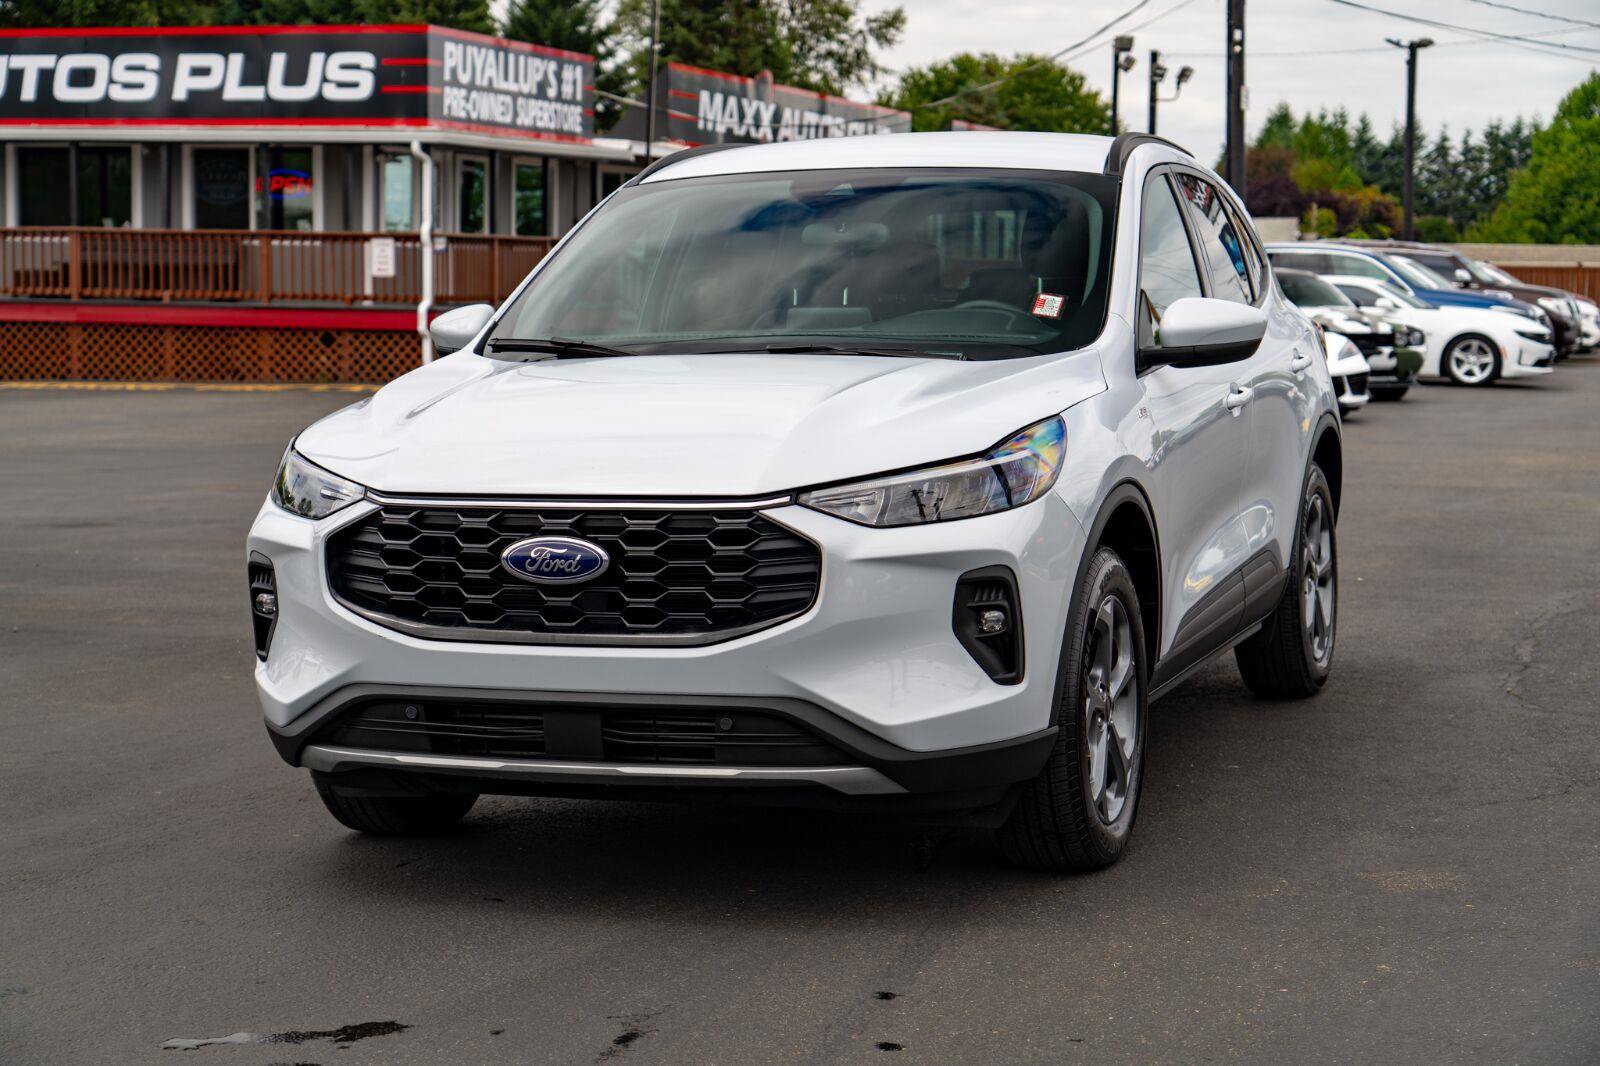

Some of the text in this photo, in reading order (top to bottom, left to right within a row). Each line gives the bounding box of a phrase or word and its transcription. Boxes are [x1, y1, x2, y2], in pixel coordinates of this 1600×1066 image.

[0, 52, 376, 102] TOS PLUS
[443, 42, 583, 100] PUYALLUP'S #1
[443, 86, 583, 133] PRE-OWNED SUPERSTORE
[697, 90, 776, 142] MAXX
[525, 546, 581, 572] Ford
